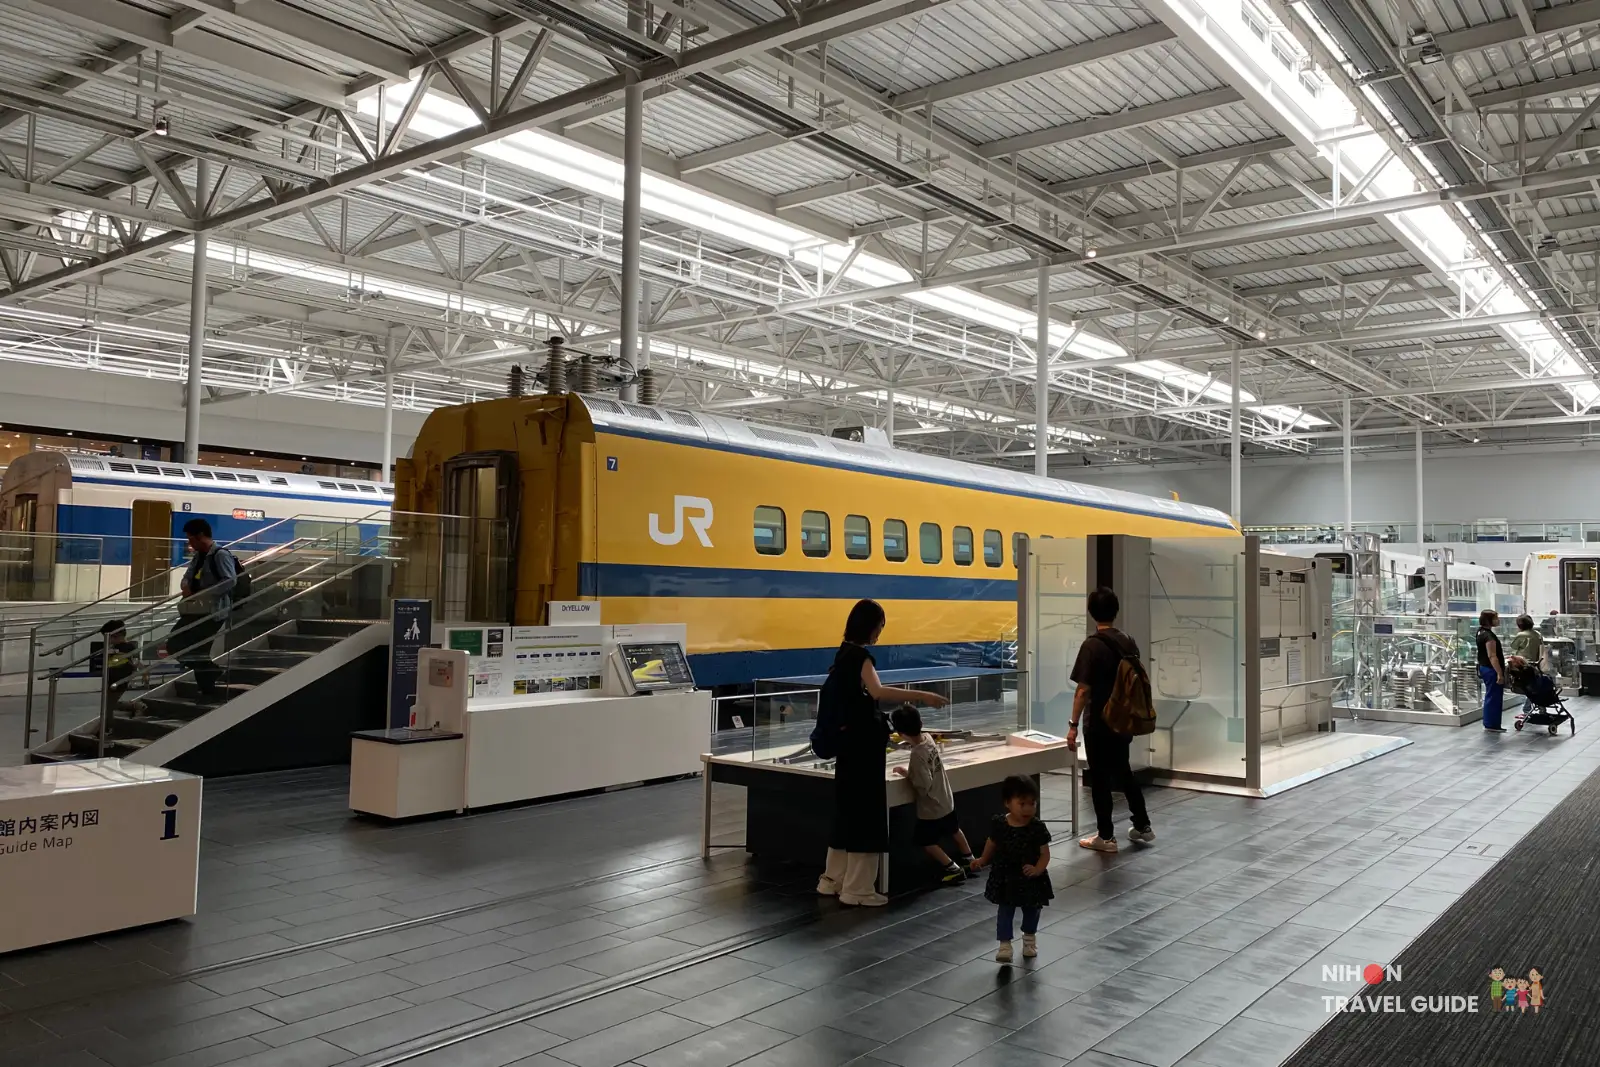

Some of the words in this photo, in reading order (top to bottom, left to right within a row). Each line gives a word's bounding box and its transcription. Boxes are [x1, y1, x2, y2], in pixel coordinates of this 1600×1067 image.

[609, 458, 616, 469] 7
[648, 494, 714, 548] JR
[0, 809, 99, 837] 館内案内図
[43, 836, 73, 849] Map
